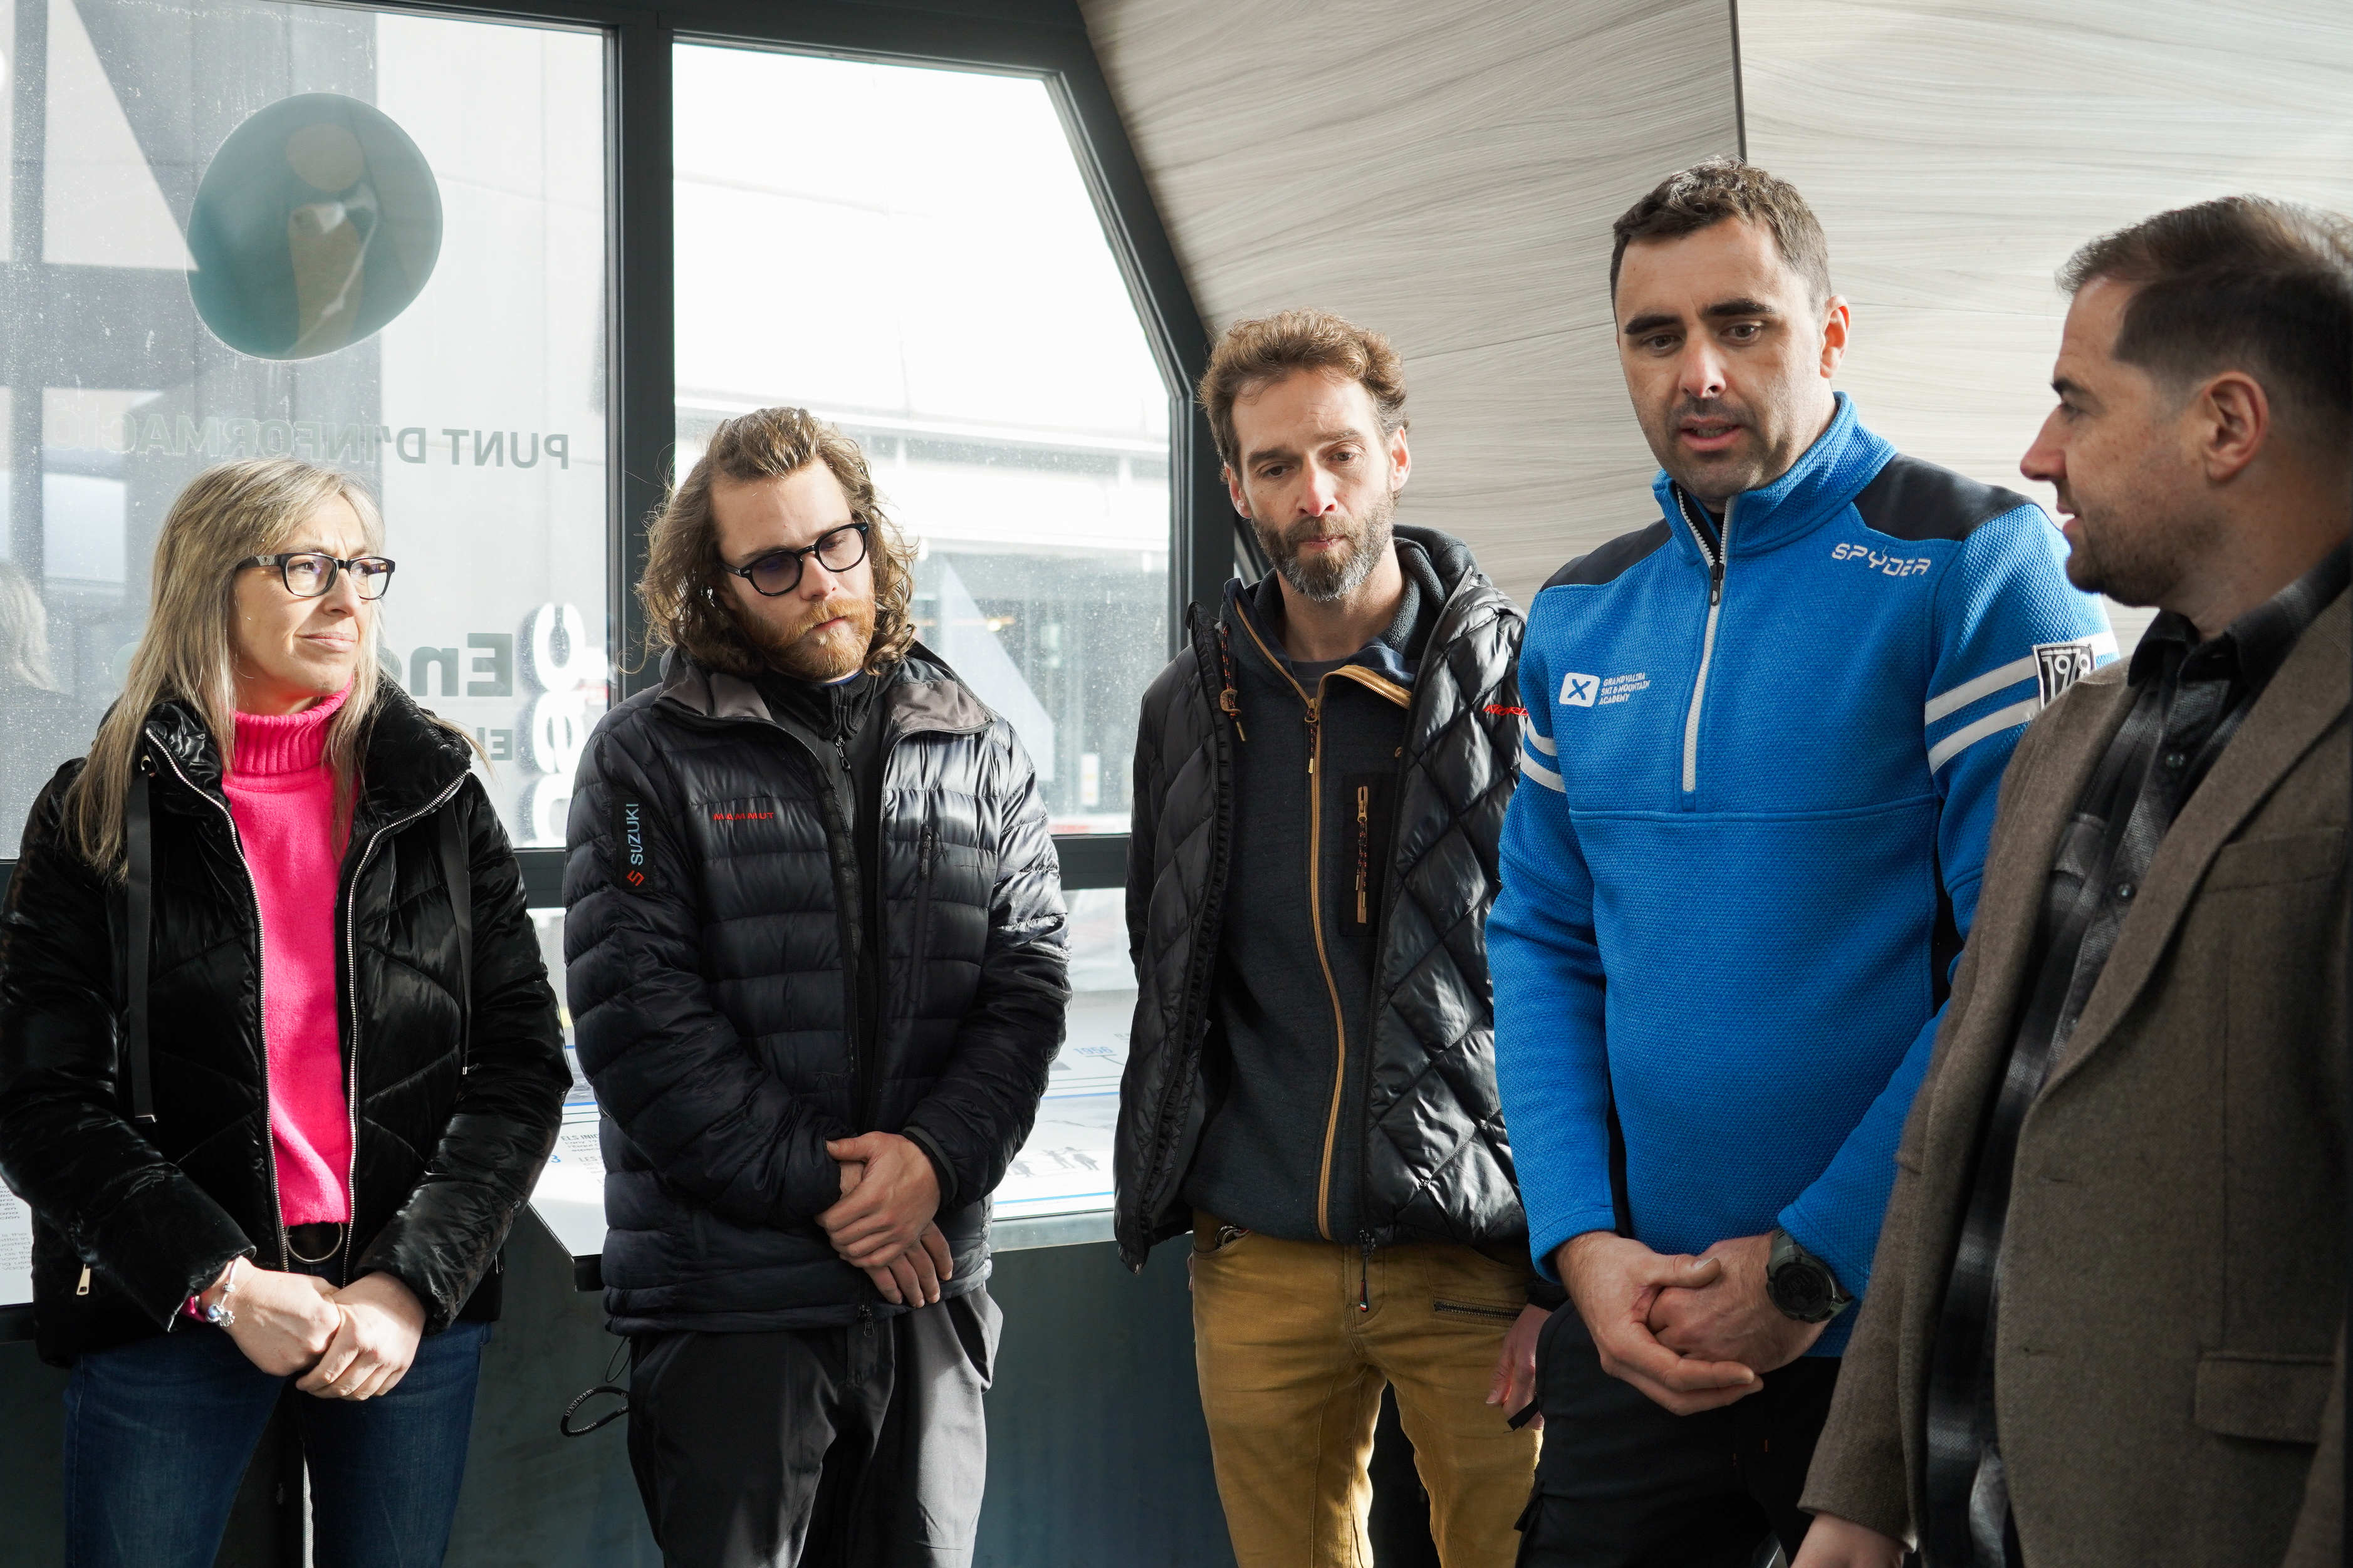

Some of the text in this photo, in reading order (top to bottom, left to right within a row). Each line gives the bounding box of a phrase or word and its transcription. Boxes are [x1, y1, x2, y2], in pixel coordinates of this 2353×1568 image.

[1832, 543, 1931, 576] SPYDER
[1603, 672, 1646, 687] GRANDVALIRA
[1601, 687, 1613, 695] SKI
[1618, 680, 1651, 693] MOUNTAIN
[1599, 693, 1630, 705] ACADEMY
[625, 803, 643, 865] SUZUKI
[1073, 1046, 1114, 1055] 1956
